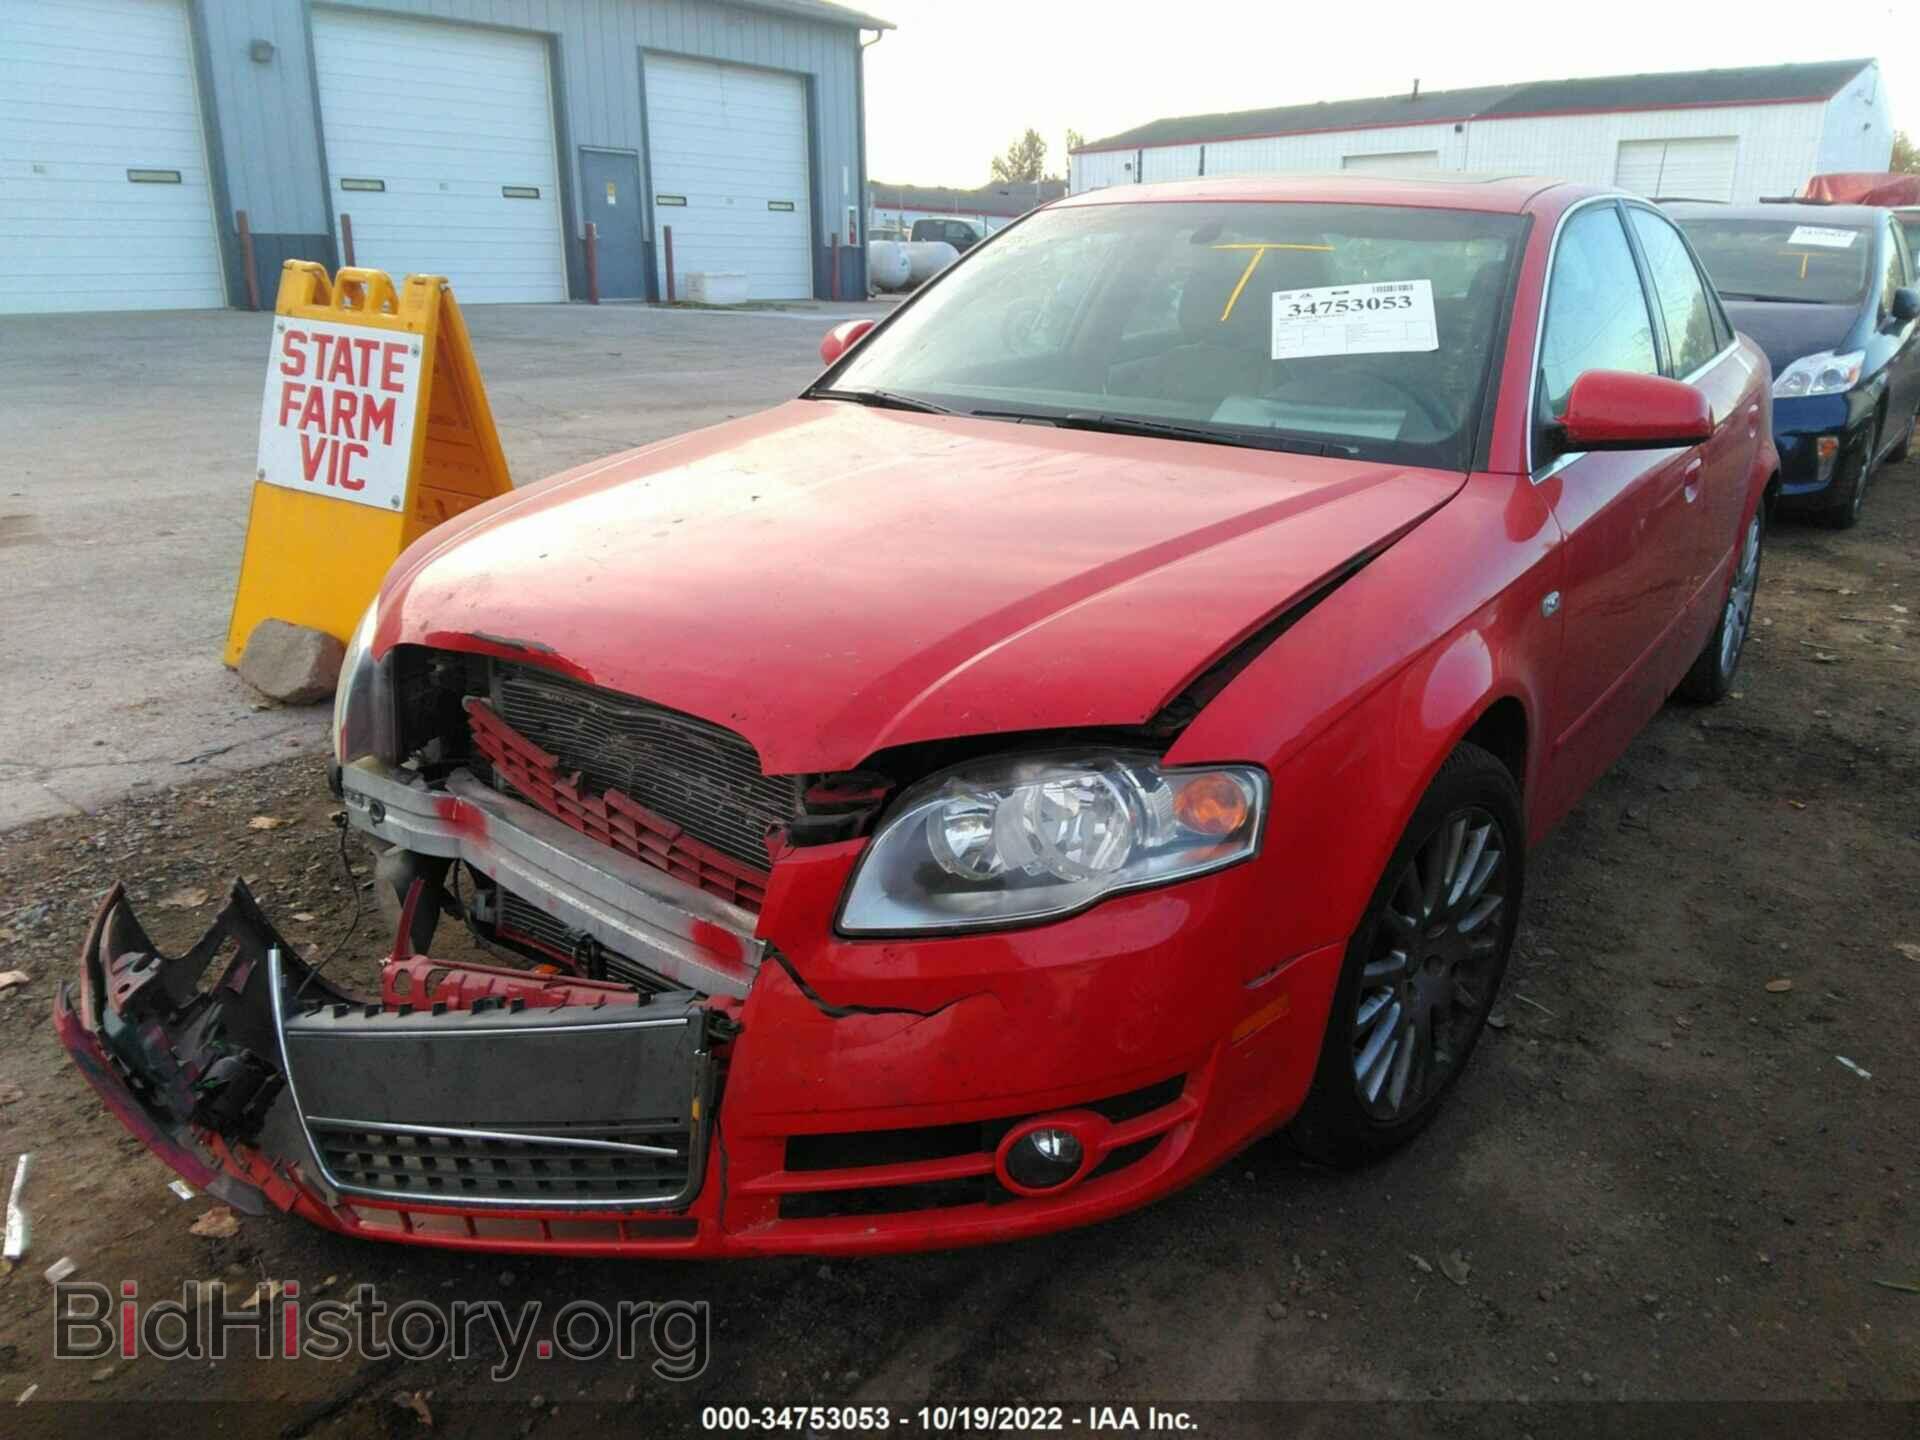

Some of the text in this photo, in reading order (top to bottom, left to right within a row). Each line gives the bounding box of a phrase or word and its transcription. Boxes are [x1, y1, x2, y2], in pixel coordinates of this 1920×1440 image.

[1287, 295, 1413, 317] 34753053
[280, 330, 409, 393] STATE
[279, 381, 396, 446] FARM
[300, 433, 369, 491] VIC
